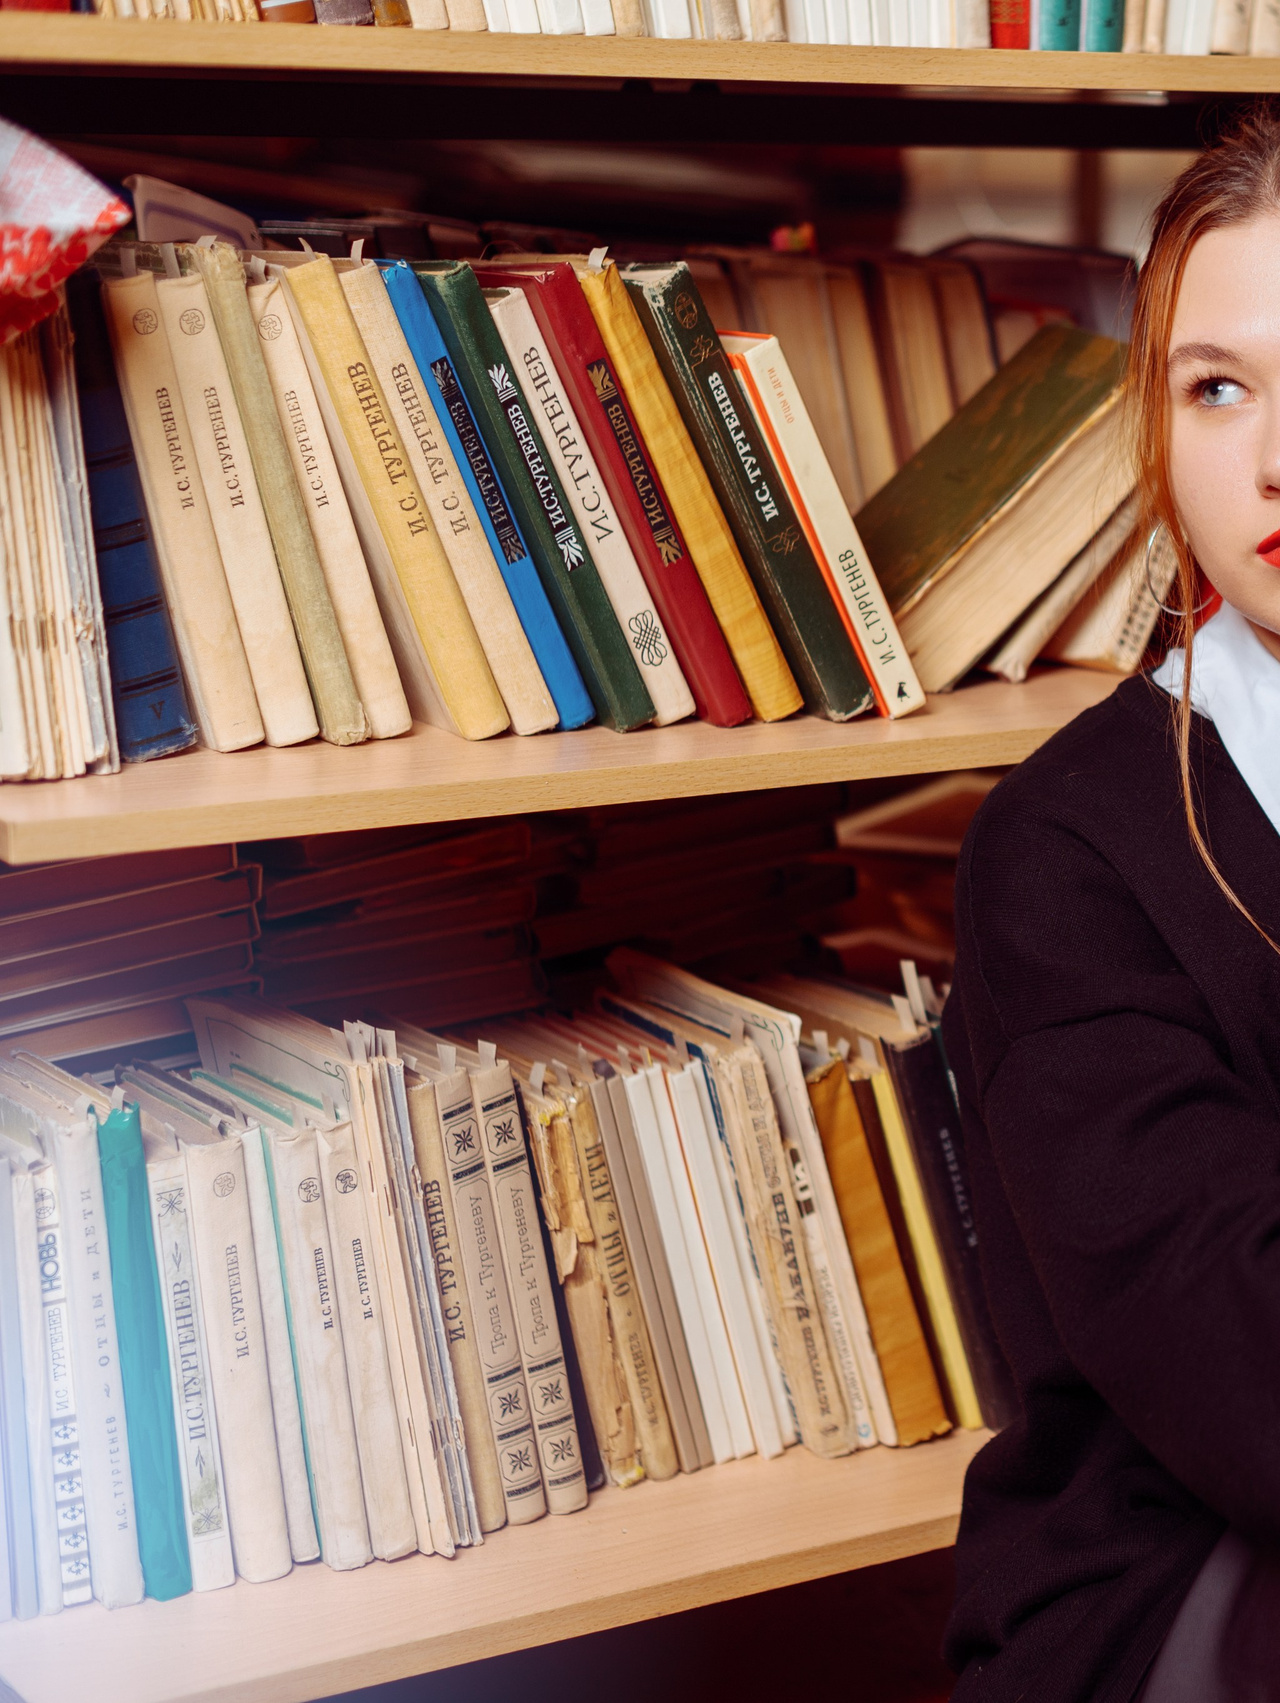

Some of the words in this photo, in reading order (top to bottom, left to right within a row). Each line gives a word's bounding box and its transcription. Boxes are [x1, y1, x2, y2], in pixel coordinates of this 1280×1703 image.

[156, 387, 187, 475] ТУРГЕНЕВ
[204, 386, 235, 474] ТУРГЕНЕВ
[284, 390, 319, 475] ТУРГЕНЕВ
[347, 361, 407, 485] ТУРГЕНЕВ
[391, 362, 449, 485] ТУРГЕНЕВ
[708, 371, 762, 484] ТУРГЕНЕВ
[838, 549, 880, 631] ТУРГЕНЕВ
[38, 1232, 62, 1294] НОВЬ
[80, 1189, 100, 1256] ДЕТИ
[423, 1179, 457, 1295] ТУРГЕНЕВ
[469, 1195, 495, 1286] Тургеневу
[510, 1187, 536, 1277] Тургеневу
[225, 1244, 246, 1326] ТУРГЕНЕВ
[314, 1247, 330, 1305] ТУРГЕНЕВ
[352, 1238, 369, 1294] ТУРГЕНЕВ
[601, 1230, 631, 1298] ОТЦЫ
[48, 1306, 67, 1382] ТУРГЕНЕВ
[92, 1291, 110, 1367] ОТЦЫ
[488, 1303, 507, 1354] Тропа
[529, 1294, 549, 1345] Тропа
[105, 1415, 125, 1500] ТУРГЕНЕВ
